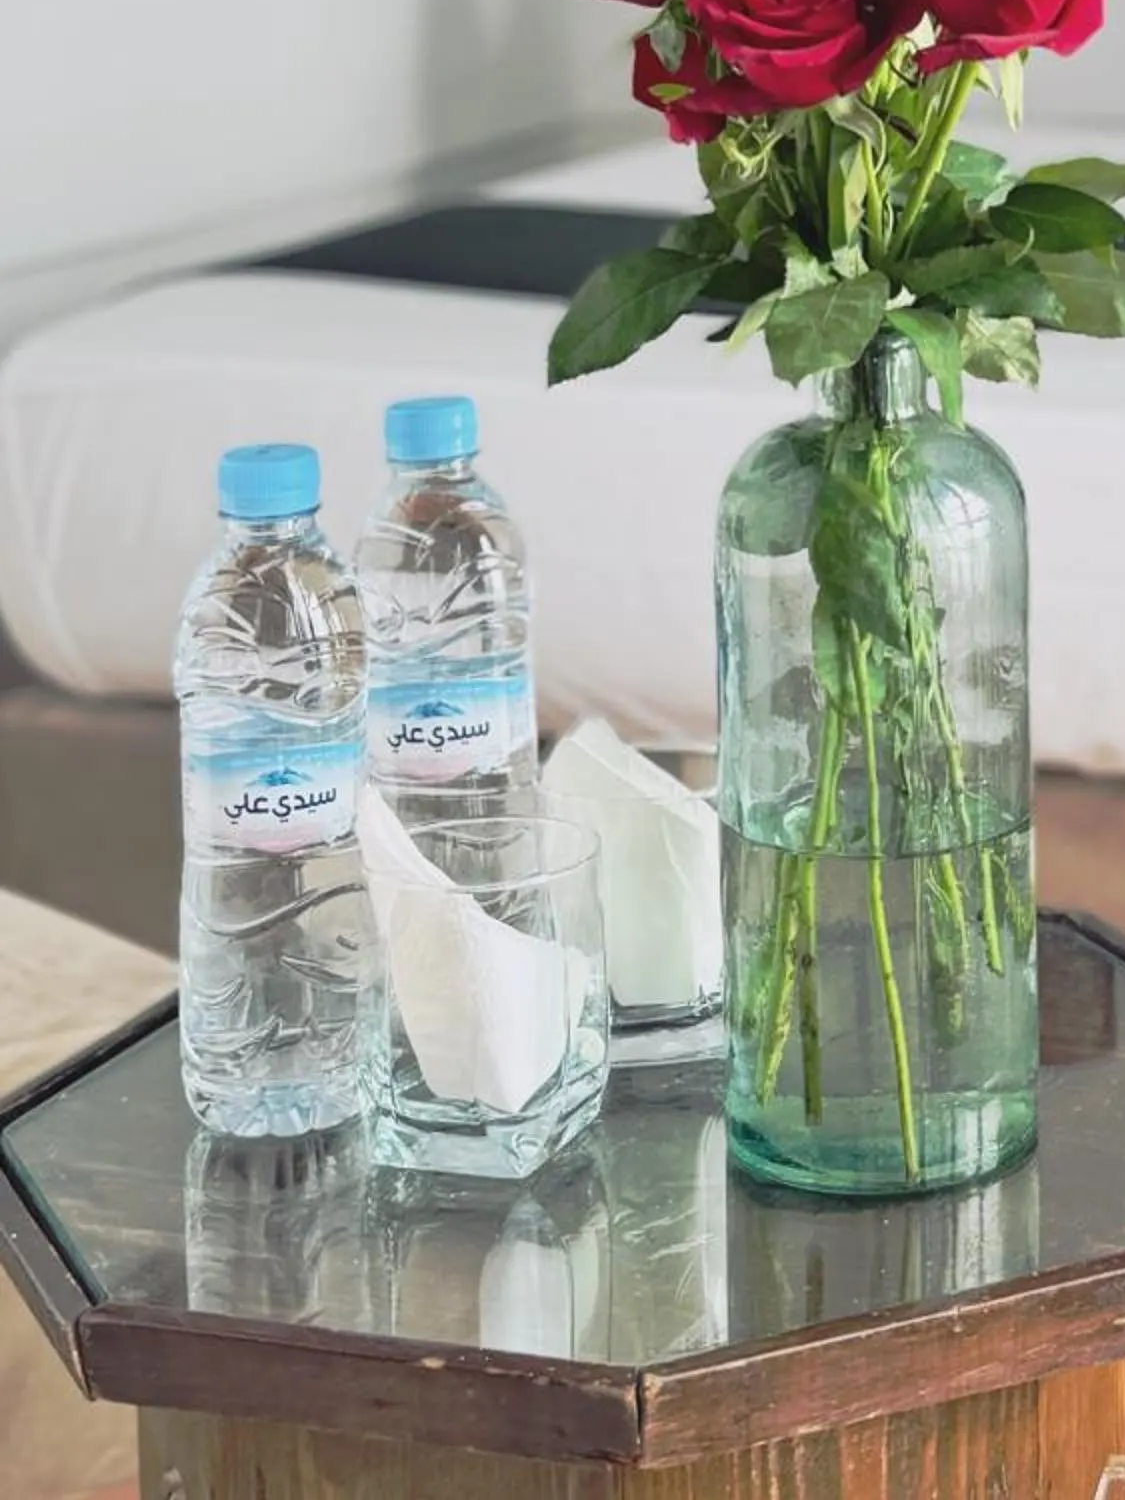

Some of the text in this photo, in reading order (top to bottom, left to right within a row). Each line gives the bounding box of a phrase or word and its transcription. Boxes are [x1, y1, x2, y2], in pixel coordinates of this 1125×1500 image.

[386, 720, 490, 754] سيدي علي
[223, 787, 337, 825] سيدي علي
